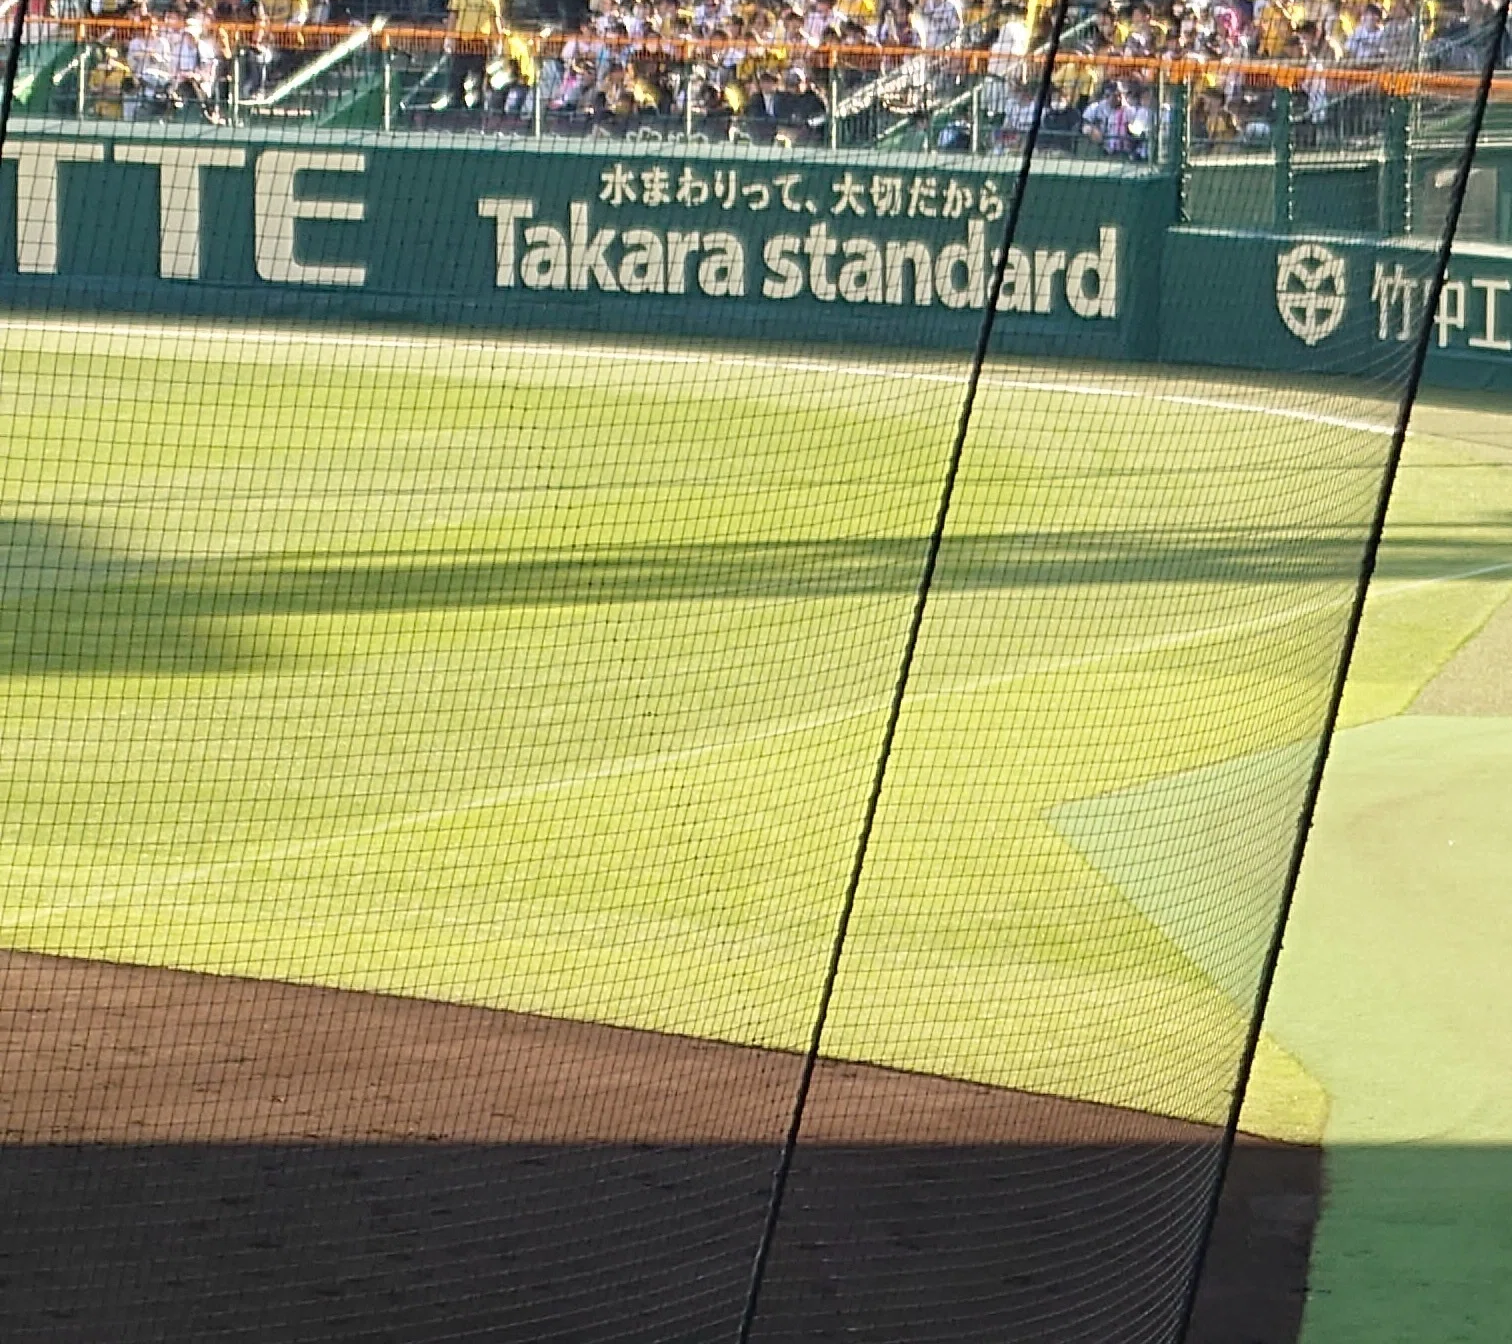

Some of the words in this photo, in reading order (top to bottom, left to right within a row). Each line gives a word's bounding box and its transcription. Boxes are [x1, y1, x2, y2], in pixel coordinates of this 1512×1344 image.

[599, 163, 1004, 222] 水まわりって、大切だから
[477, 197, 745, 298] Takara
[762, 218, 1117, 319] standard
